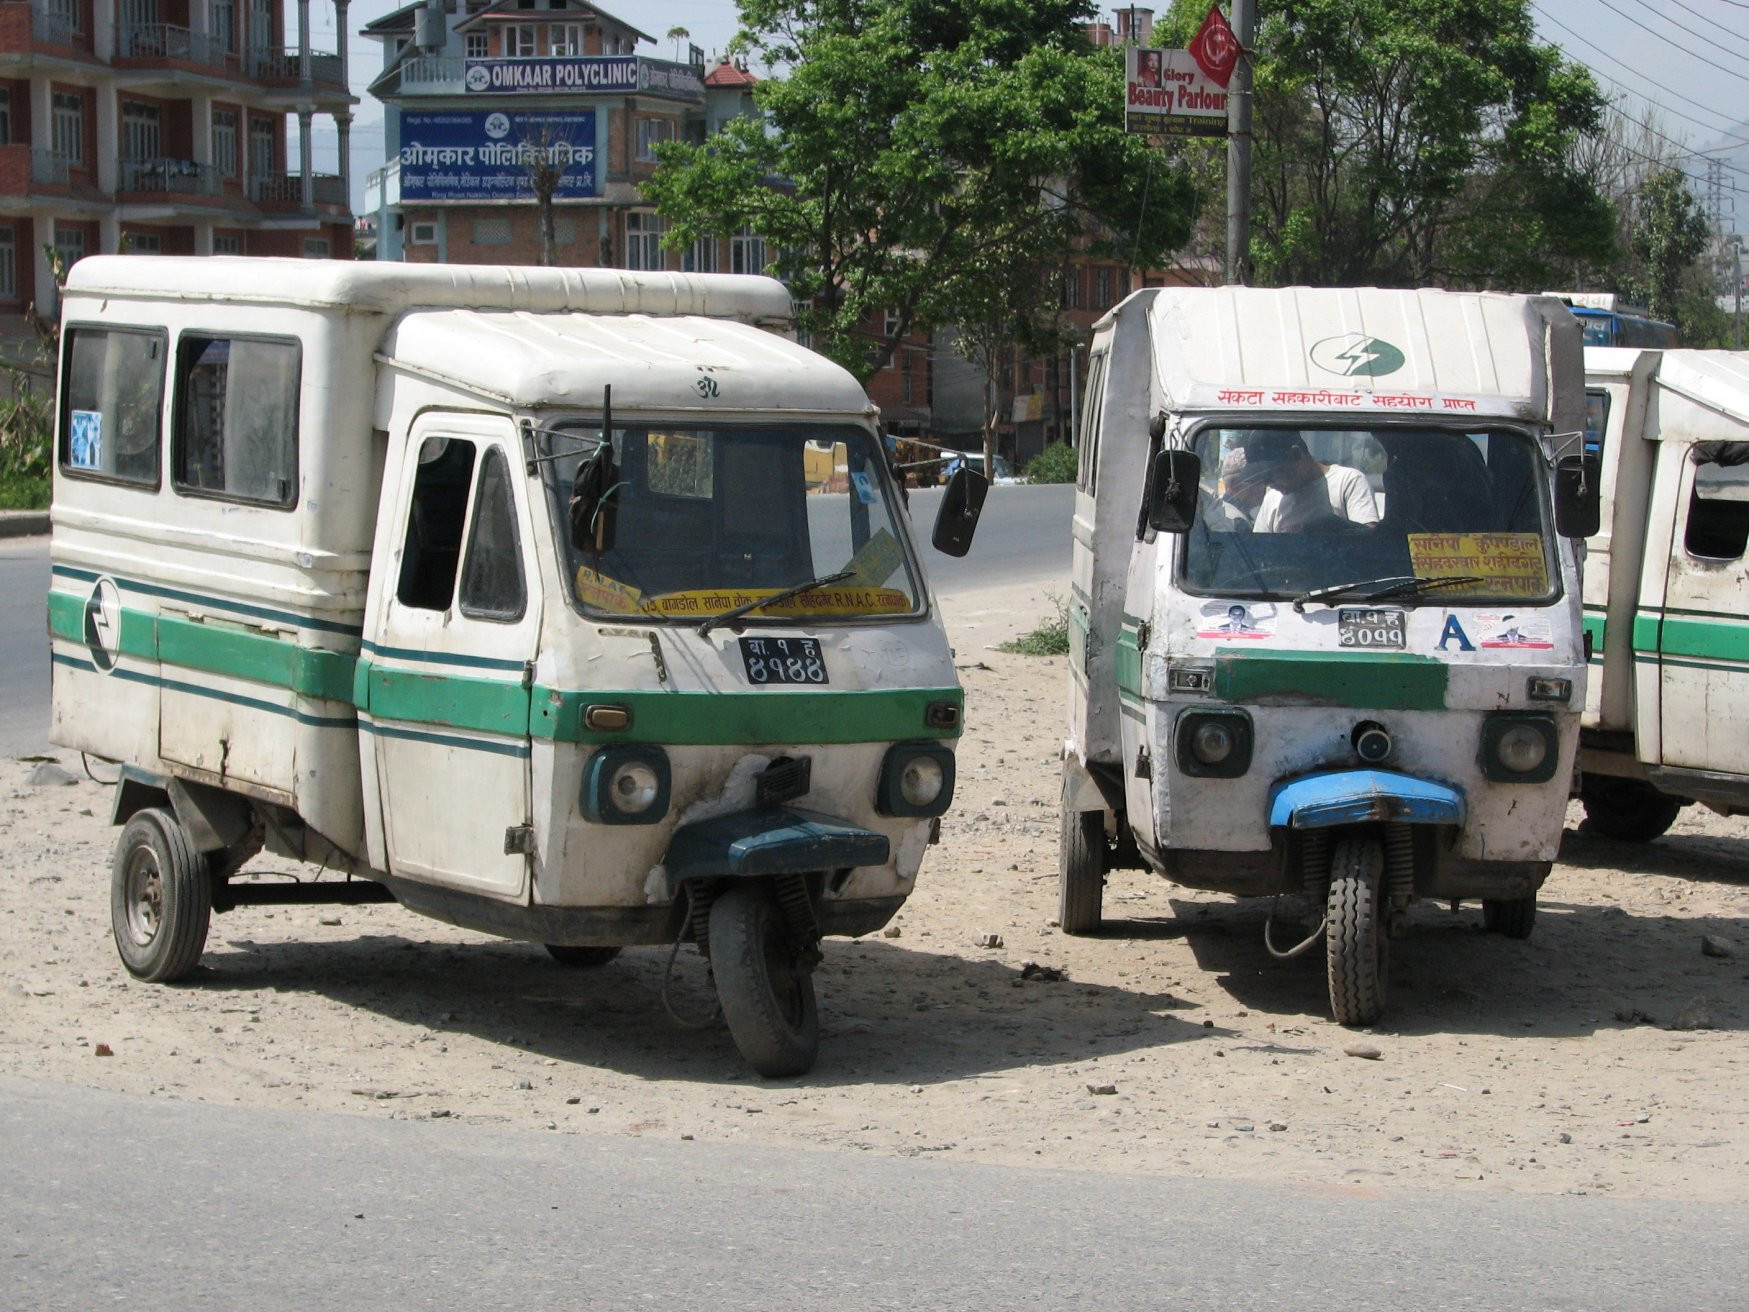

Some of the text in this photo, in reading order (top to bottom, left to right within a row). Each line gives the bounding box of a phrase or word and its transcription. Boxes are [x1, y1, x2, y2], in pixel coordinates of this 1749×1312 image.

[492, 64, 551, 87] OMKAAR
[556, 62, 636, 86] POLYCLINIC
[1163, 68, 1195, 85] Glory
[1128, 81, 1228, 114] Beauty Parlour
[1217, 389, 1265, 405] संकटा
[1372, 392, 1433, 408] सहयोग
[1441, 398, 1476, 412] प्राप्त
[1434, 614, 1476, 651] A
